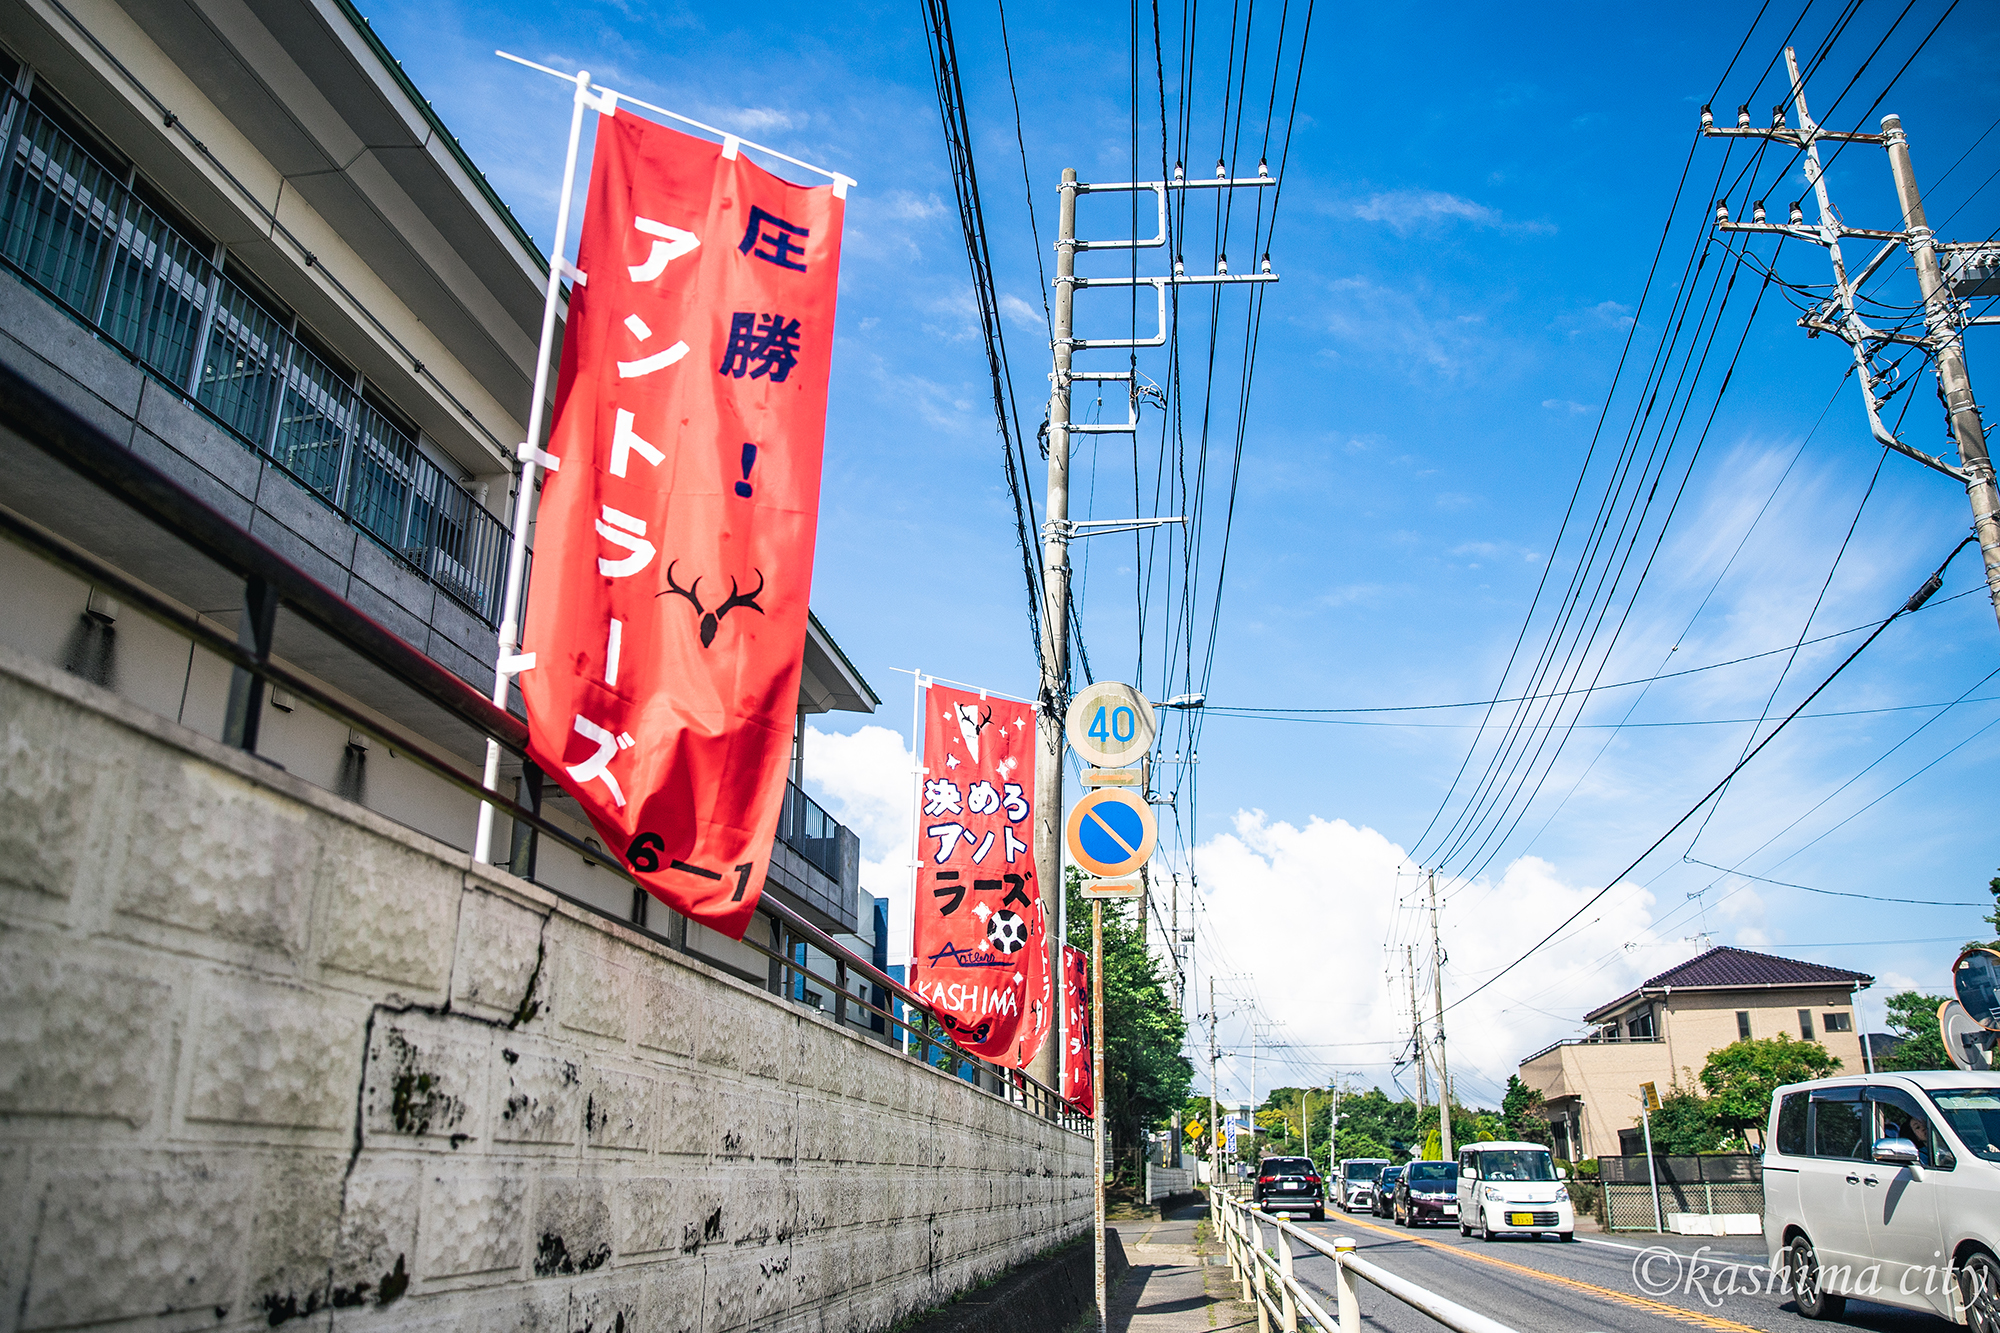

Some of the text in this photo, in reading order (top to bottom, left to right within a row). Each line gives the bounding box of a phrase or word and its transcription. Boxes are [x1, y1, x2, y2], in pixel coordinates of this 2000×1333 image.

[565, 216, 701, 808] アントラーズ
[1088, 705, 1135, 742] 40
[923, 778, 1030, 823] 決めろ
[933, 871, 1033, 916] ラーズ
[918, 981, 1018, 1017] KASHIMA
